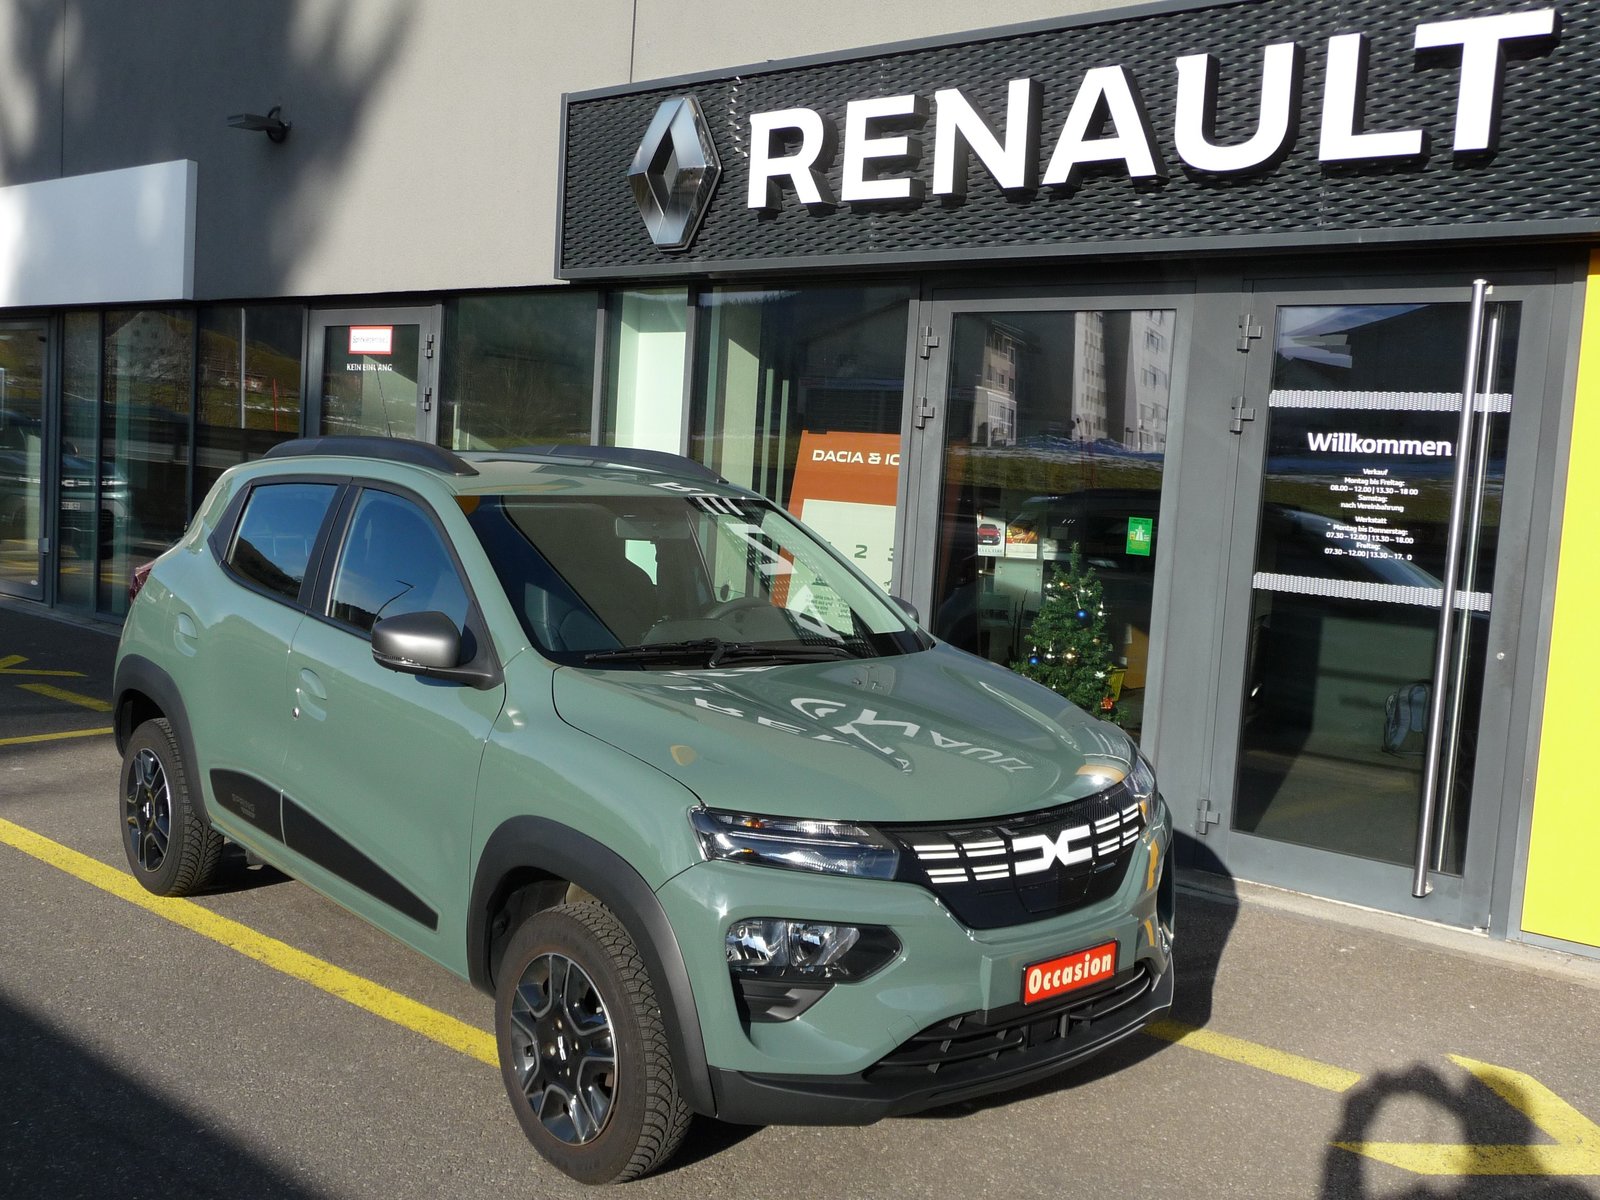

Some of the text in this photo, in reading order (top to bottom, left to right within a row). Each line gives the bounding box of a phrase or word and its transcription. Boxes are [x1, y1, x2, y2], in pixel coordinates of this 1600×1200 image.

[748, 8, 1557, 211] RENAULT
[346, 363, 361, 371] KEIN
[1307, 432, 1453, 457] Willkommen
[812, 449, 864, 464] DACIA
[868, 452, 882, 465] &
[1362, 468, 1389, 476] Verkauf
[1344, 477, 1369, 486] Montag
[1380, 479, 1405, 488] Freitag:
[1358, 494, 1388, 503] Samstag:
[1355, 516, 1387, 524] Werkstatt
[1333, 524, 1408, 536] Montag bis Donnerstag:
[1350, 533, 1367, 541] 12.00
[854, 544, 868, 559] 2
[1356, 542, 1381, 551] Freitag:
[1348, 549, 1366, 557] 12.00
[1028, 953, 1112, 995] Occasion
